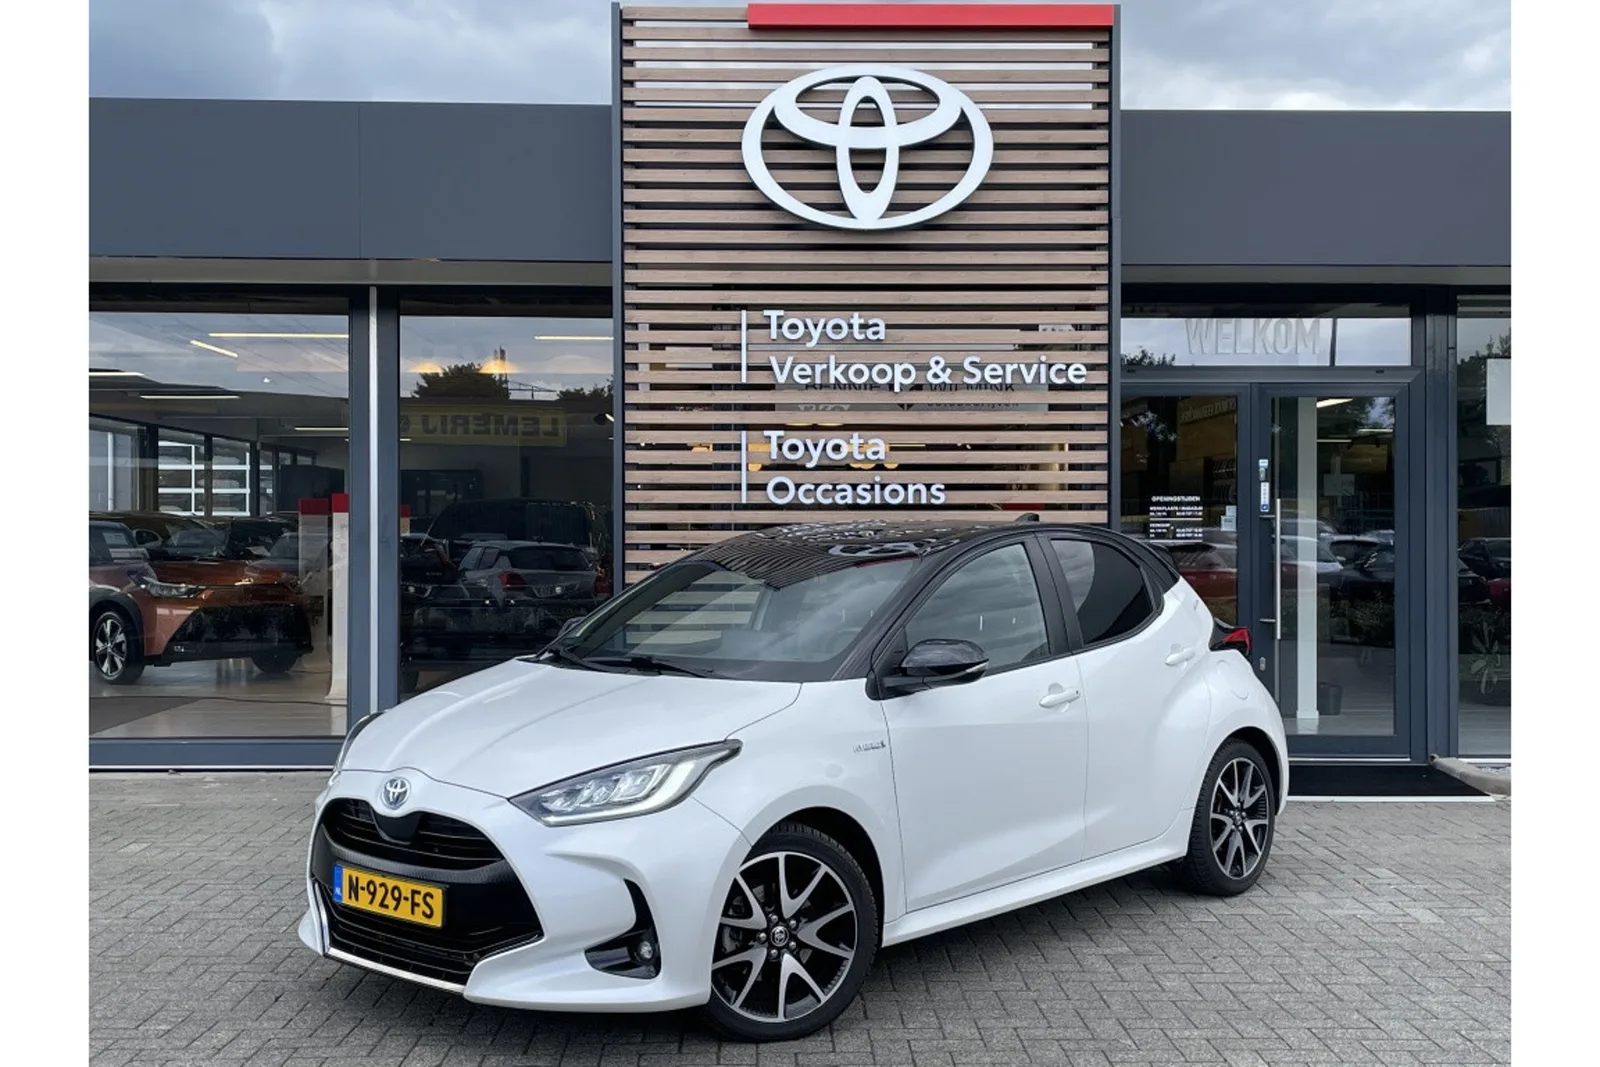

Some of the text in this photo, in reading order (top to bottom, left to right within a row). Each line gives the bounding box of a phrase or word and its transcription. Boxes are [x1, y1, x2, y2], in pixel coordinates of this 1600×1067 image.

[763, 309, 886, 348] Toyota
[1184, 318, 1320, 355] WELKOM
[769, 354, 1088, 393] Verkoop & Service
[763, 430, 886, 468] Toyota
[766, 475, 946, 505] Occasions
[348, 874, 435, 920] N-929-FS
